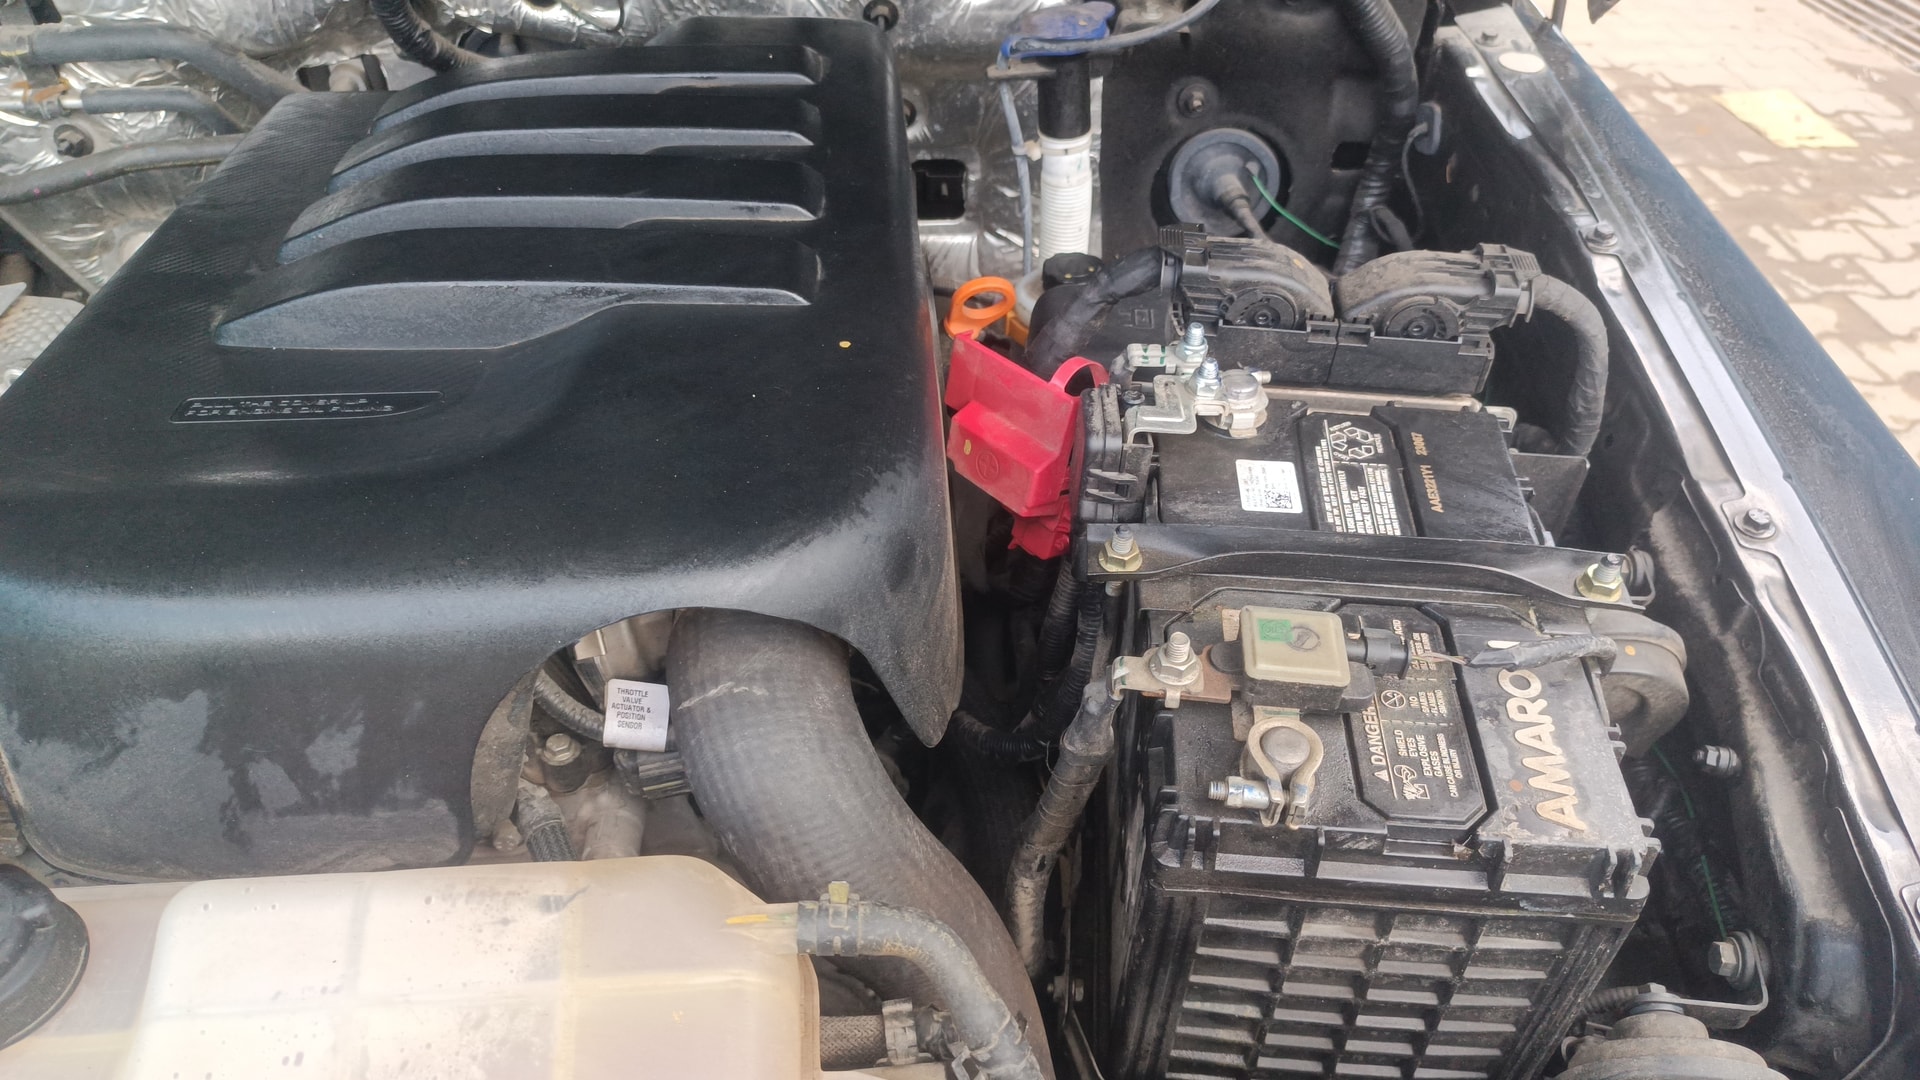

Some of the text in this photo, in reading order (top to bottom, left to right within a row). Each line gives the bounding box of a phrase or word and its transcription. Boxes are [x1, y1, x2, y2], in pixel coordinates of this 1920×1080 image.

[278, 398, 341, 407] COVER
[184, 404, 395, 417] FOR ENGINE OIL FILLING
[1357, 486, 1367, 499] FAST
[1392, 619, 1404, 636] ACID
[617, 687, 649, 698] THROTTLE
[622, 696, 643, 704] VALVE
[611, 702, 645, 713] ACTUATOR
[1408, 696, 1419, 708] NO
[1418, 691, 1430, 713] SPARKS
[1427, 691, 1439, 714] FLAMES
[616, 711, 646, 721] POSITION
[617, 720, 643, 730] SENSOR
[1393, 729, 1409, 757] SHIELD
[1405, 737, 1419, 757] EYES
[1415, 734, 1433, 776] EXPLOSIVE
[1429, 750, 1443, 777] GASES
[1436, 733, 1460, 798] CAN CAUSE BLINDNESS
[1448, 748, 1464, 779] OR INJURY
